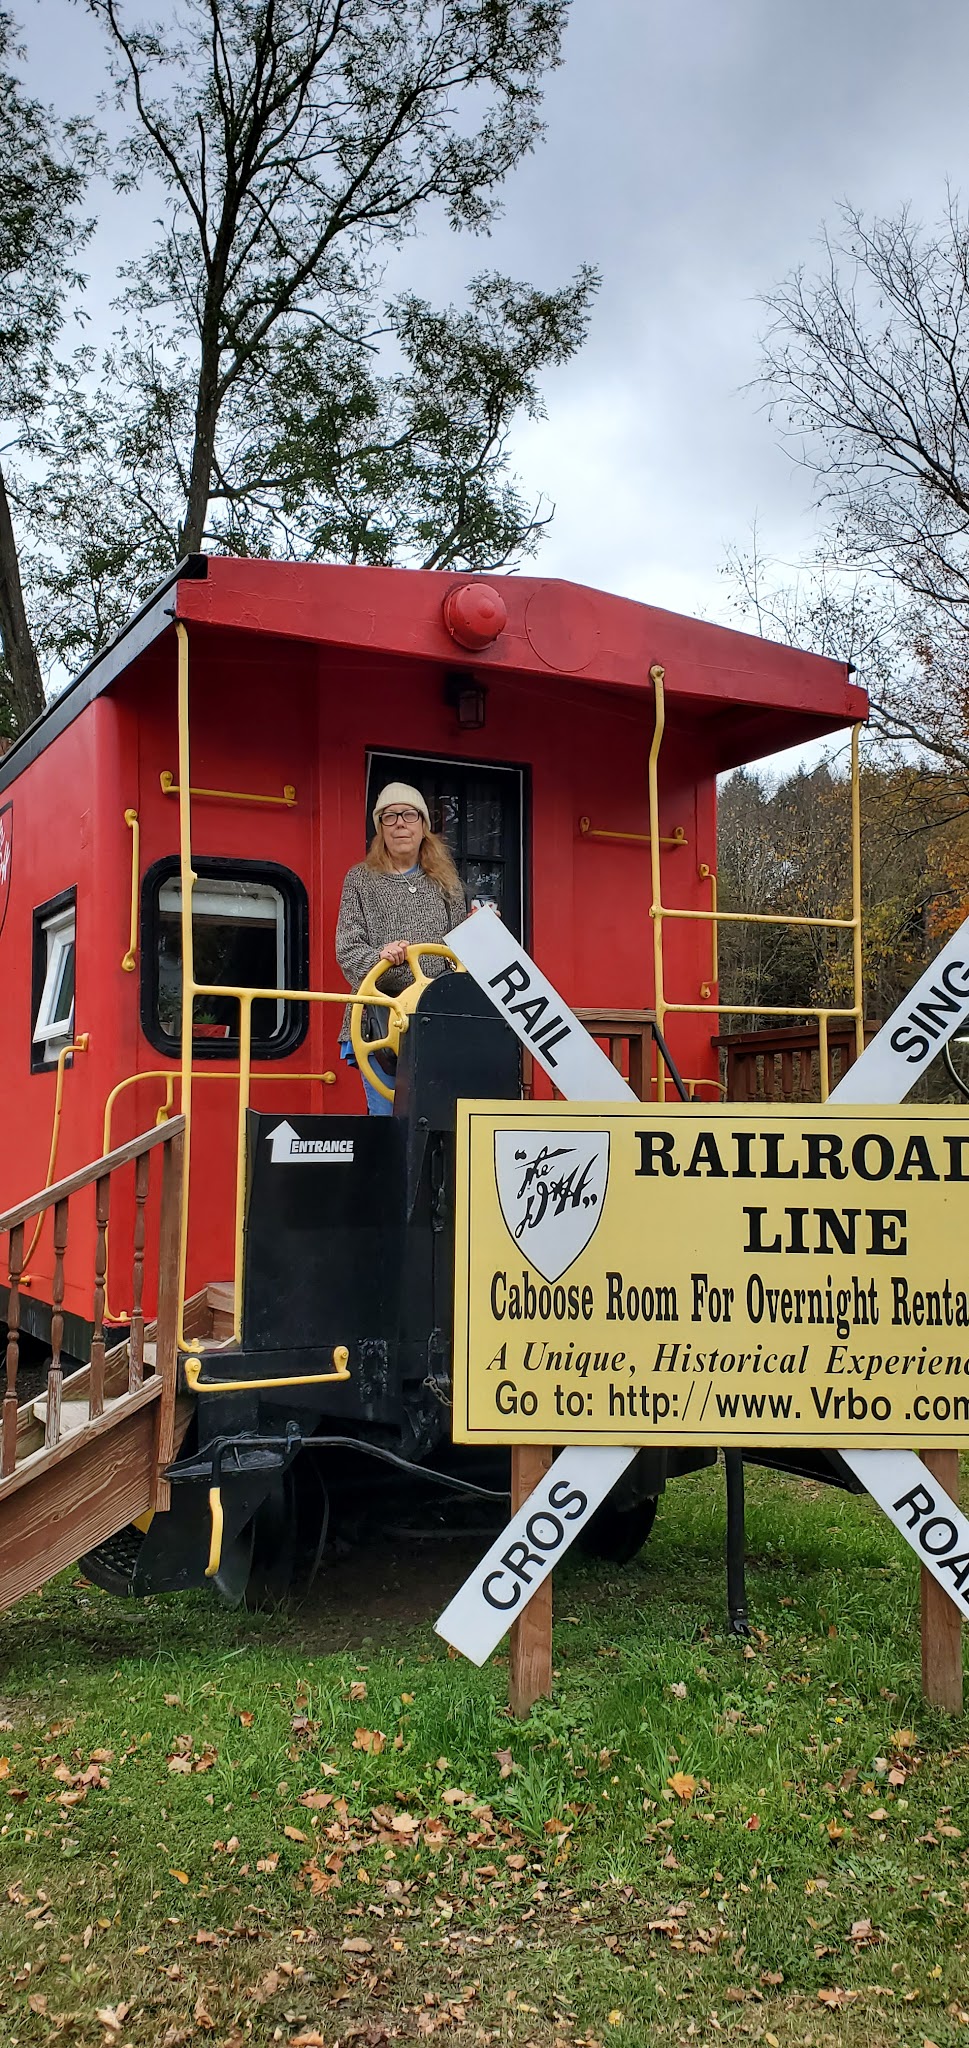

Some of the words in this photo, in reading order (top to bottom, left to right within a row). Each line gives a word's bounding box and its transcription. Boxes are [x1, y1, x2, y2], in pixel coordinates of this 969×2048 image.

[488, 960, 572, 1069] RAIL
[889, 960, 969, 1063] SING
[291, 1140, 354, 1153] ENTRANCE
[742, 1206, 908, 1256] LINE
[490, 1271, 594, 1321] Caboose
[605, 1271, 680, 1322] Room
[691, 1273, 735, 1323] For
[746, 1273, 880, 1340] Overnight
[485, 1342, 508, 1372] A
[523, 1341, 637, 1379] Unique,
[652, 1343, 810, 1375] Historical
[495, 1380, 538, 1416] Go
[554, 1384, 594, 1417] to:
[810, 1386, 892, 1421] Vrbo
[482, 1480, 588, 1611] CROS
[892, 1482, 969, 1605] ROA
